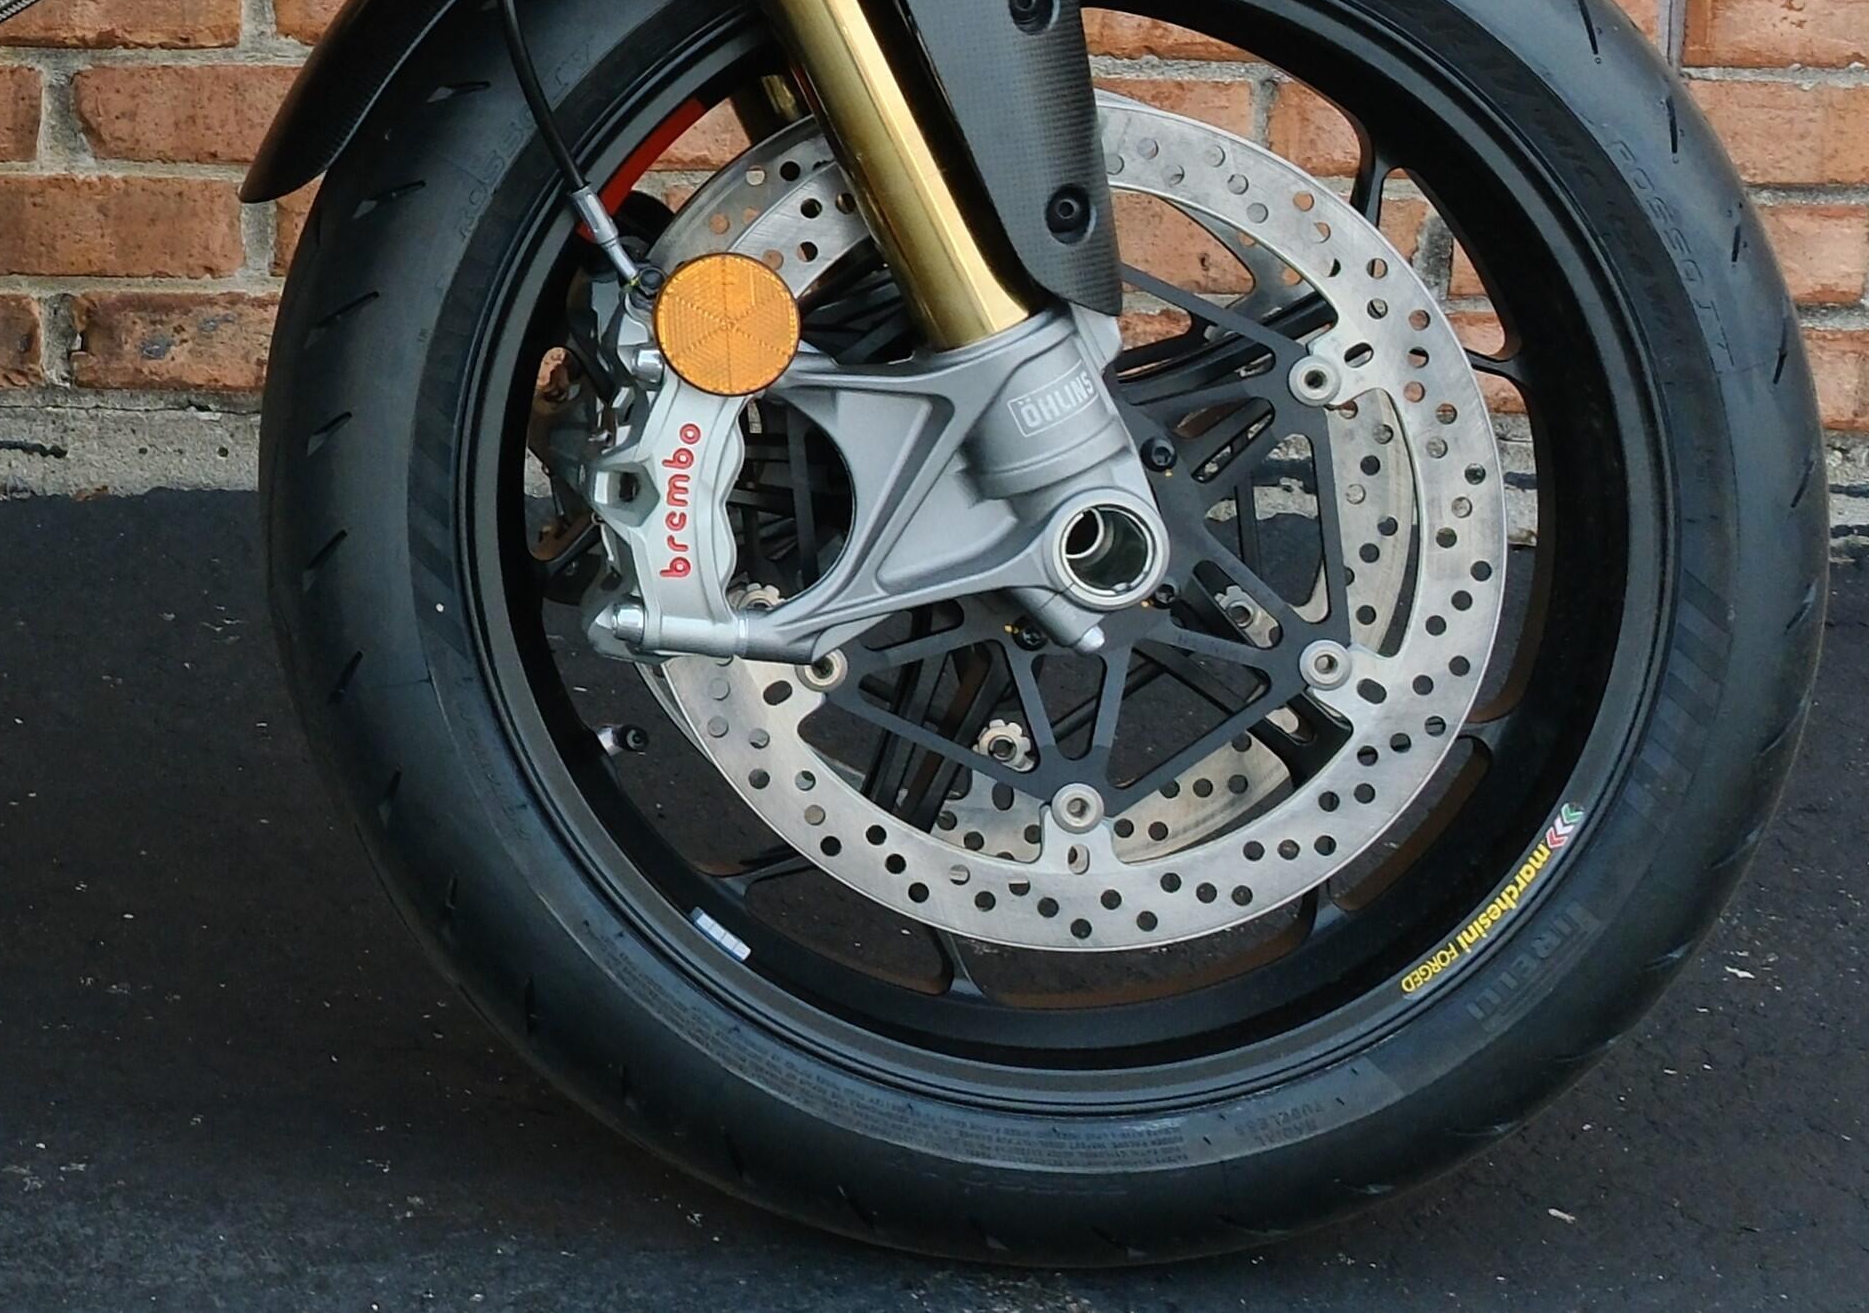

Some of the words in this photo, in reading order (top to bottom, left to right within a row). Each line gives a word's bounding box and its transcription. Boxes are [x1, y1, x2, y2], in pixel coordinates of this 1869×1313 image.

[1019, 371, 1094, 427] ÖHLINS
[660, 422, 701, 578] brembo
[1457, 844, 1551, 953] marchesini
[1400, 942, 1461, 994] FORGED
